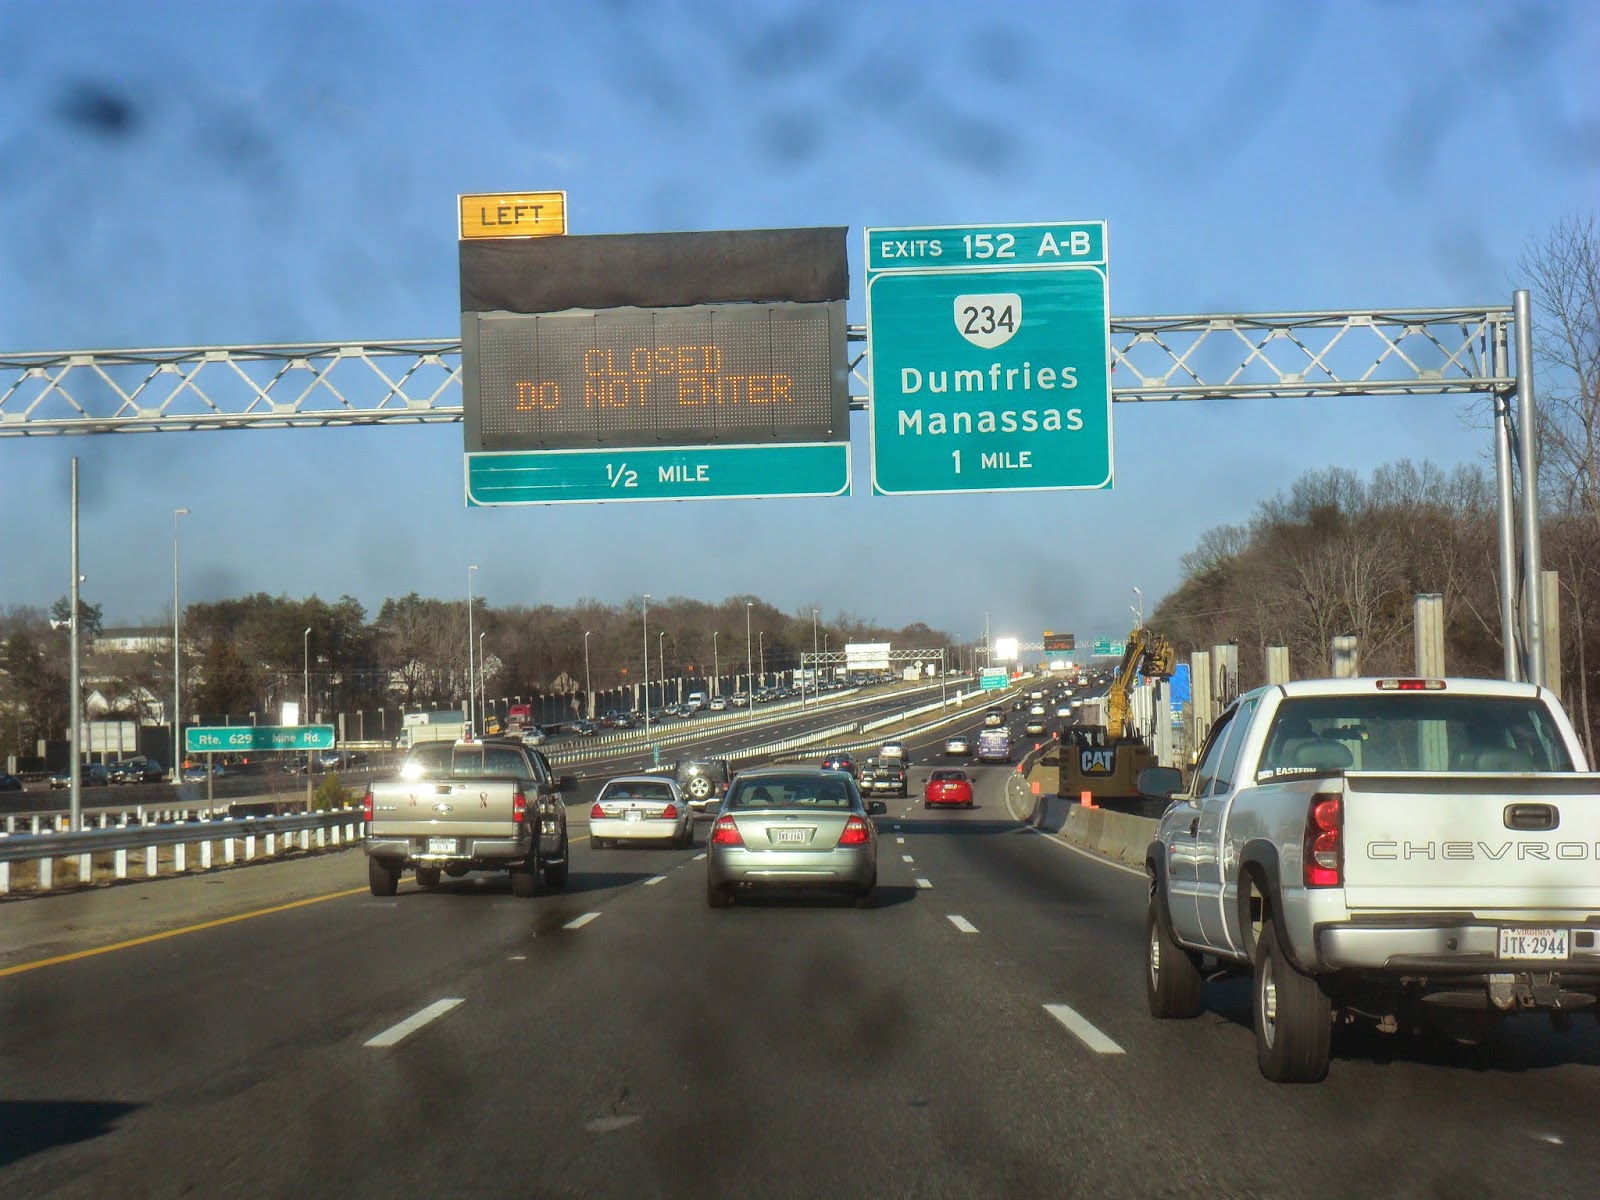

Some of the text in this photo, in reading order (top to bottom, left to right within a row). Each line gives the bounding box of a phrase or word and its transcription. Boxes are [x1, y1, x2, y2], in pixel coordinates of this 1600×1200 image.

[481, 205, 544, 226] LEFT
[881, 231, 1091, 259] EXITS 152 A-B
[963, 305, 1014, 335] 234
[584, 345, 722, 377] CLOSED
[901, 361, 1078, 394] Dumfries
[515, 374, 793, 411] DO NOT ENTER
[898, 407, 1084, 436] Manassas
[605, 462, 710, 488] 1/2 MILE
[951, 449, 1033, 474] 1 MILE
[199, 734, 222, 745] Rte.
[228, 733, 253, 744] 629
[272, 733, 296, 743] Mine
[303, 732, 321, 743] Rd.
[1081, 751, 1113, 772] CAT
[1367, 841, 1600, 860] CHEVRO
